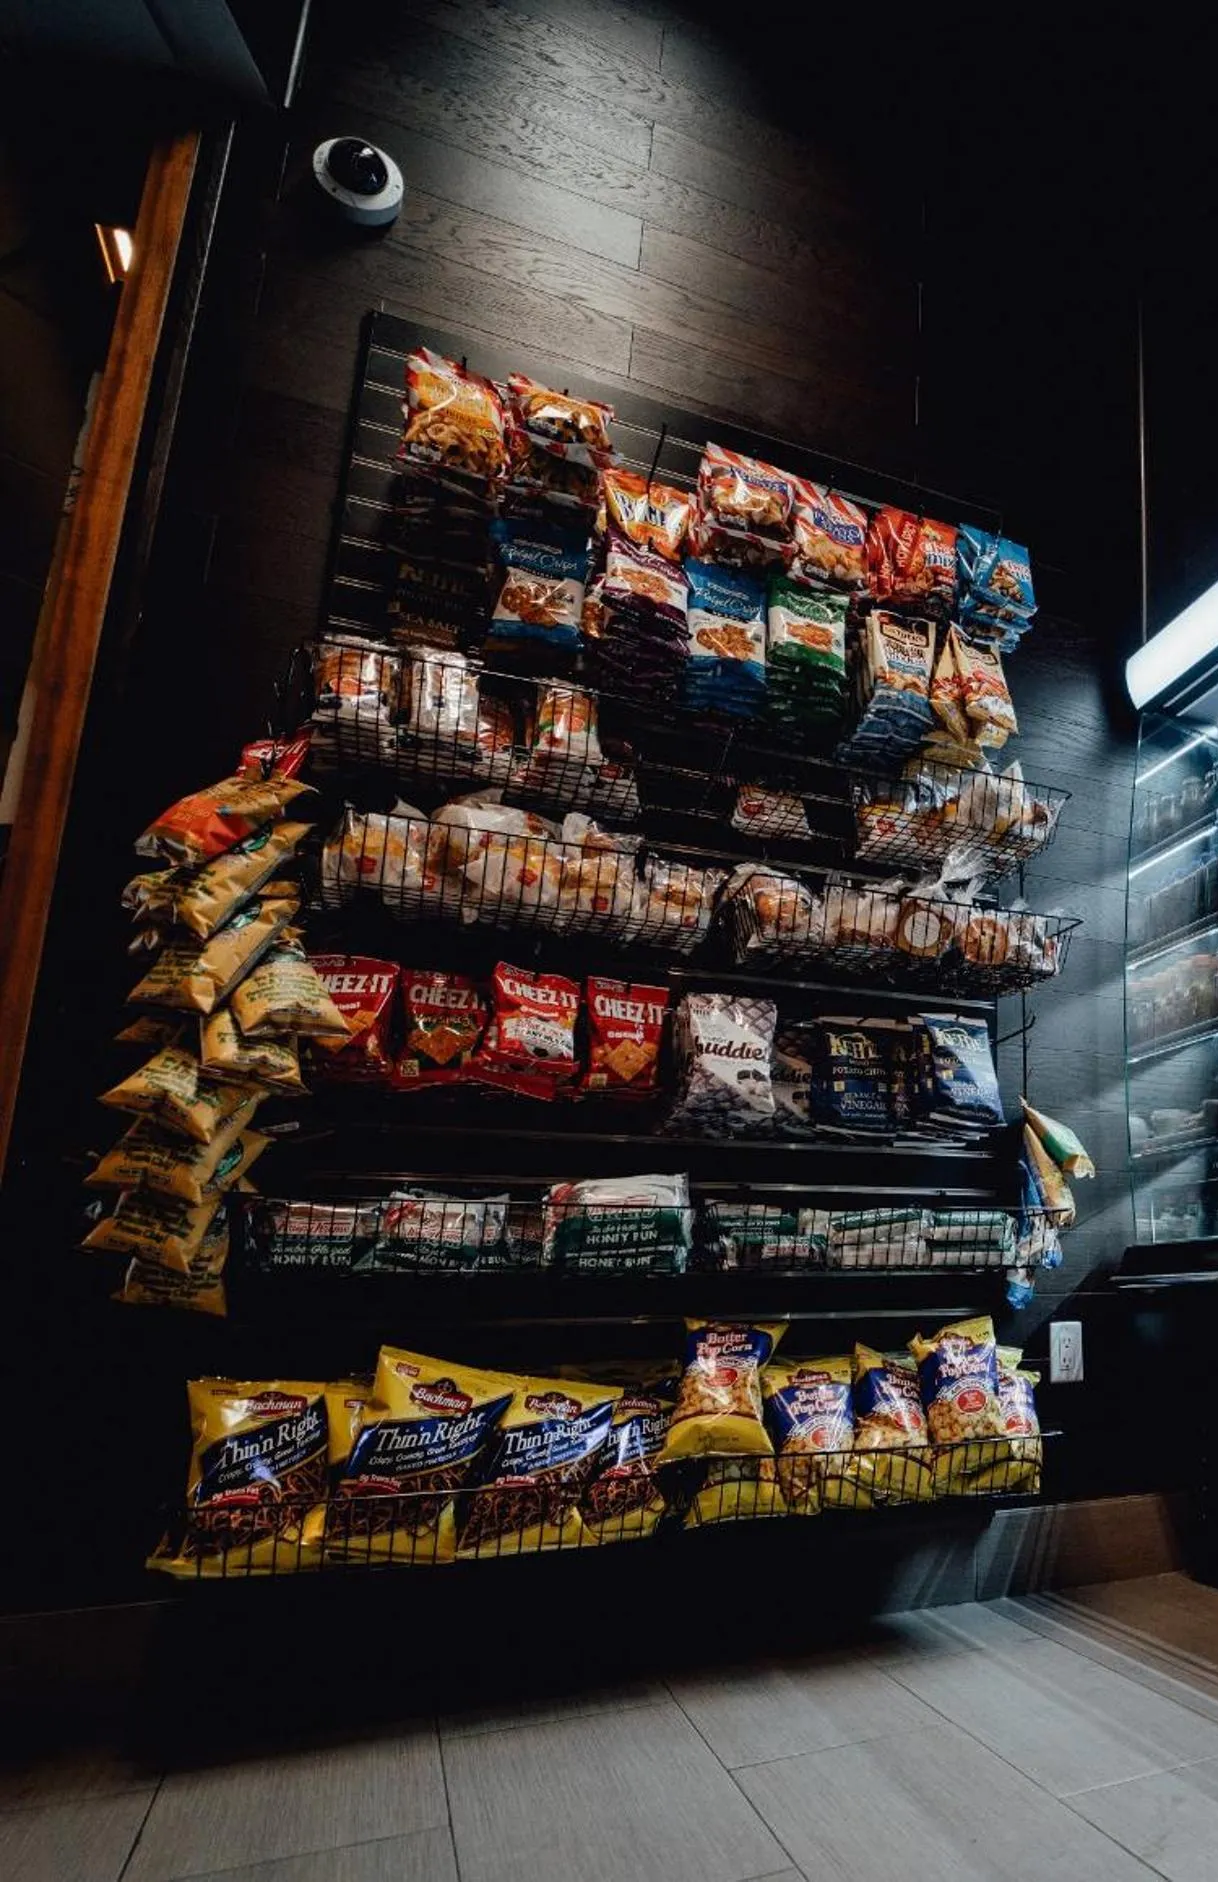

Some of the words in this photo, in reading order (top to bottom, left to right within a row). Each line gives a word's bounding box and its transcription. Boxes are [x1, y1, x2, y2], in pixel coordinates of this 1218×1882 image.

[318, 973, 394, 993] HEEZ-IT
[415, 1387, 468, 1410] Bachman
[432, 1411, 485, 1444] Right
